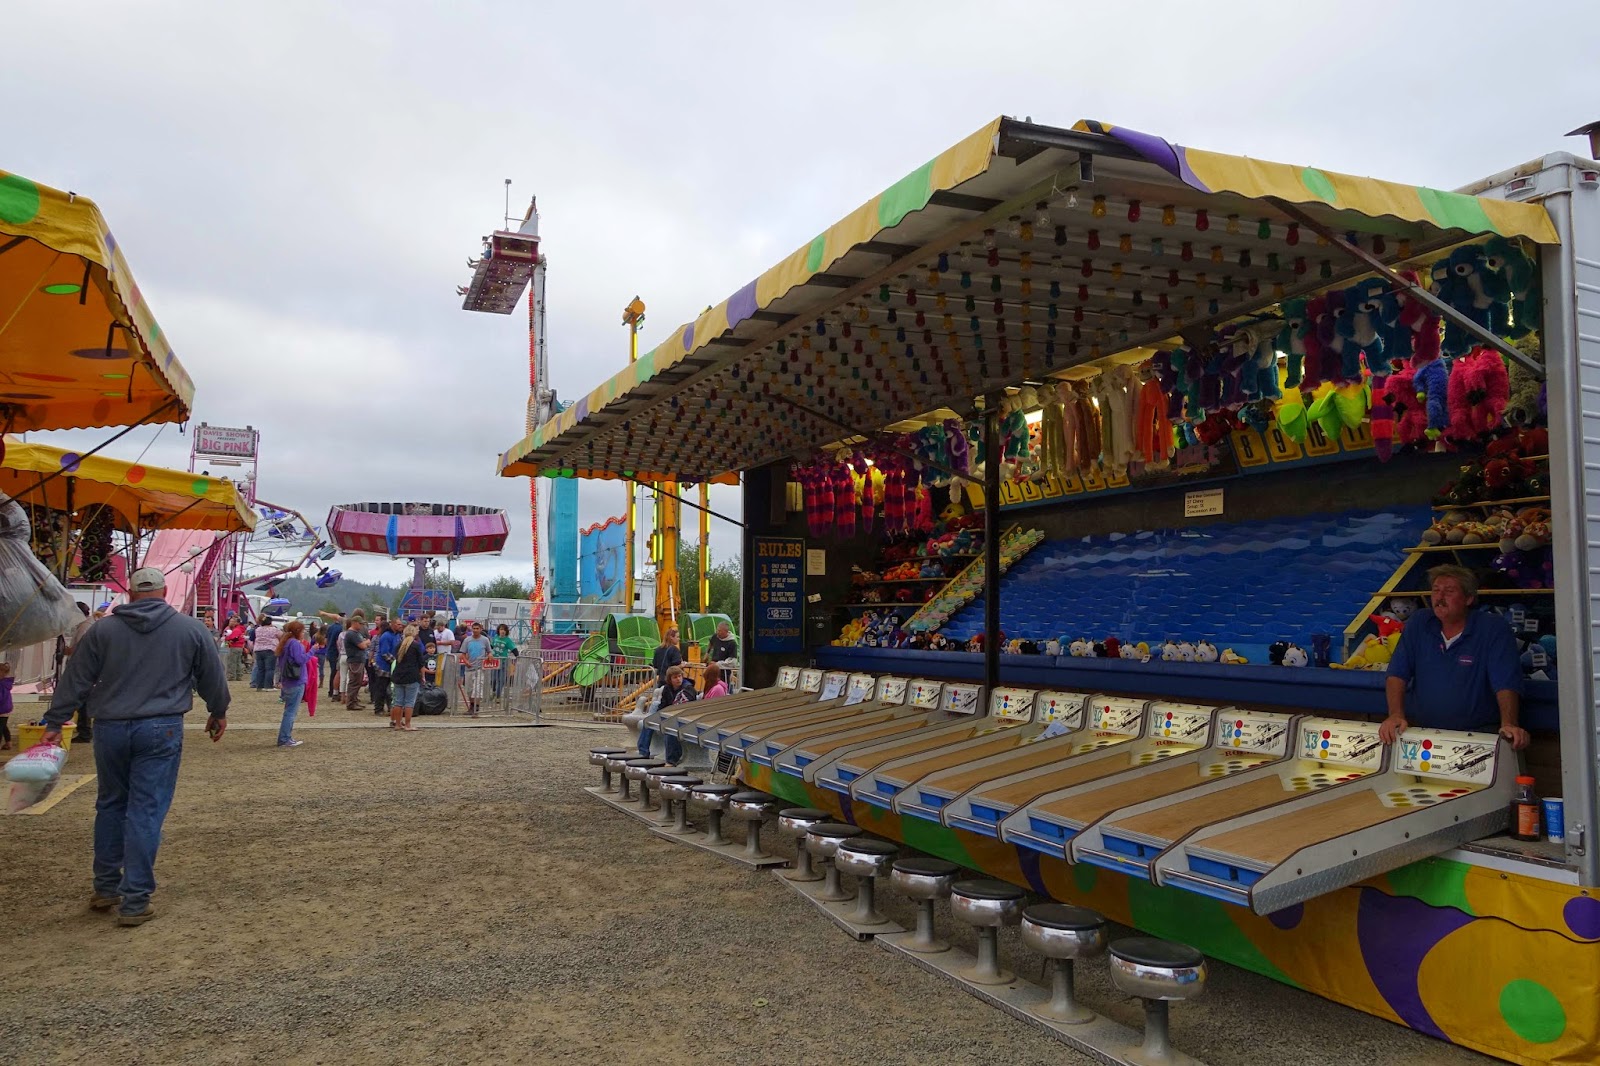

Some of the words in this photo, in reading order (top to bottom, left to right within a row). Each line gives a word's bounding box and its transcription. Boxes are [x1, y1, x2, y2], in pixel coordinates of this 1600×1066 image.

[202, 438, 221, 450] BIG
[224, 442, 250, 453] PINK
[1240, 435, 1253, 458] 8
[1273, 429, 1286, 453] 9
[1004, 480, 1013, 498] 2
[758, 542, 802, 557] RULES
[761, 564, 768, 575] 1
[760, 577, 769, 589] 2
[760, 591, 769, 602] 3
[1222, 724, 1233, 738] 12
[1305, 734, 1319, 749] 13
[1452, 744, 1471, 753] Drag
[1403, 744, 1417, 760] 14
